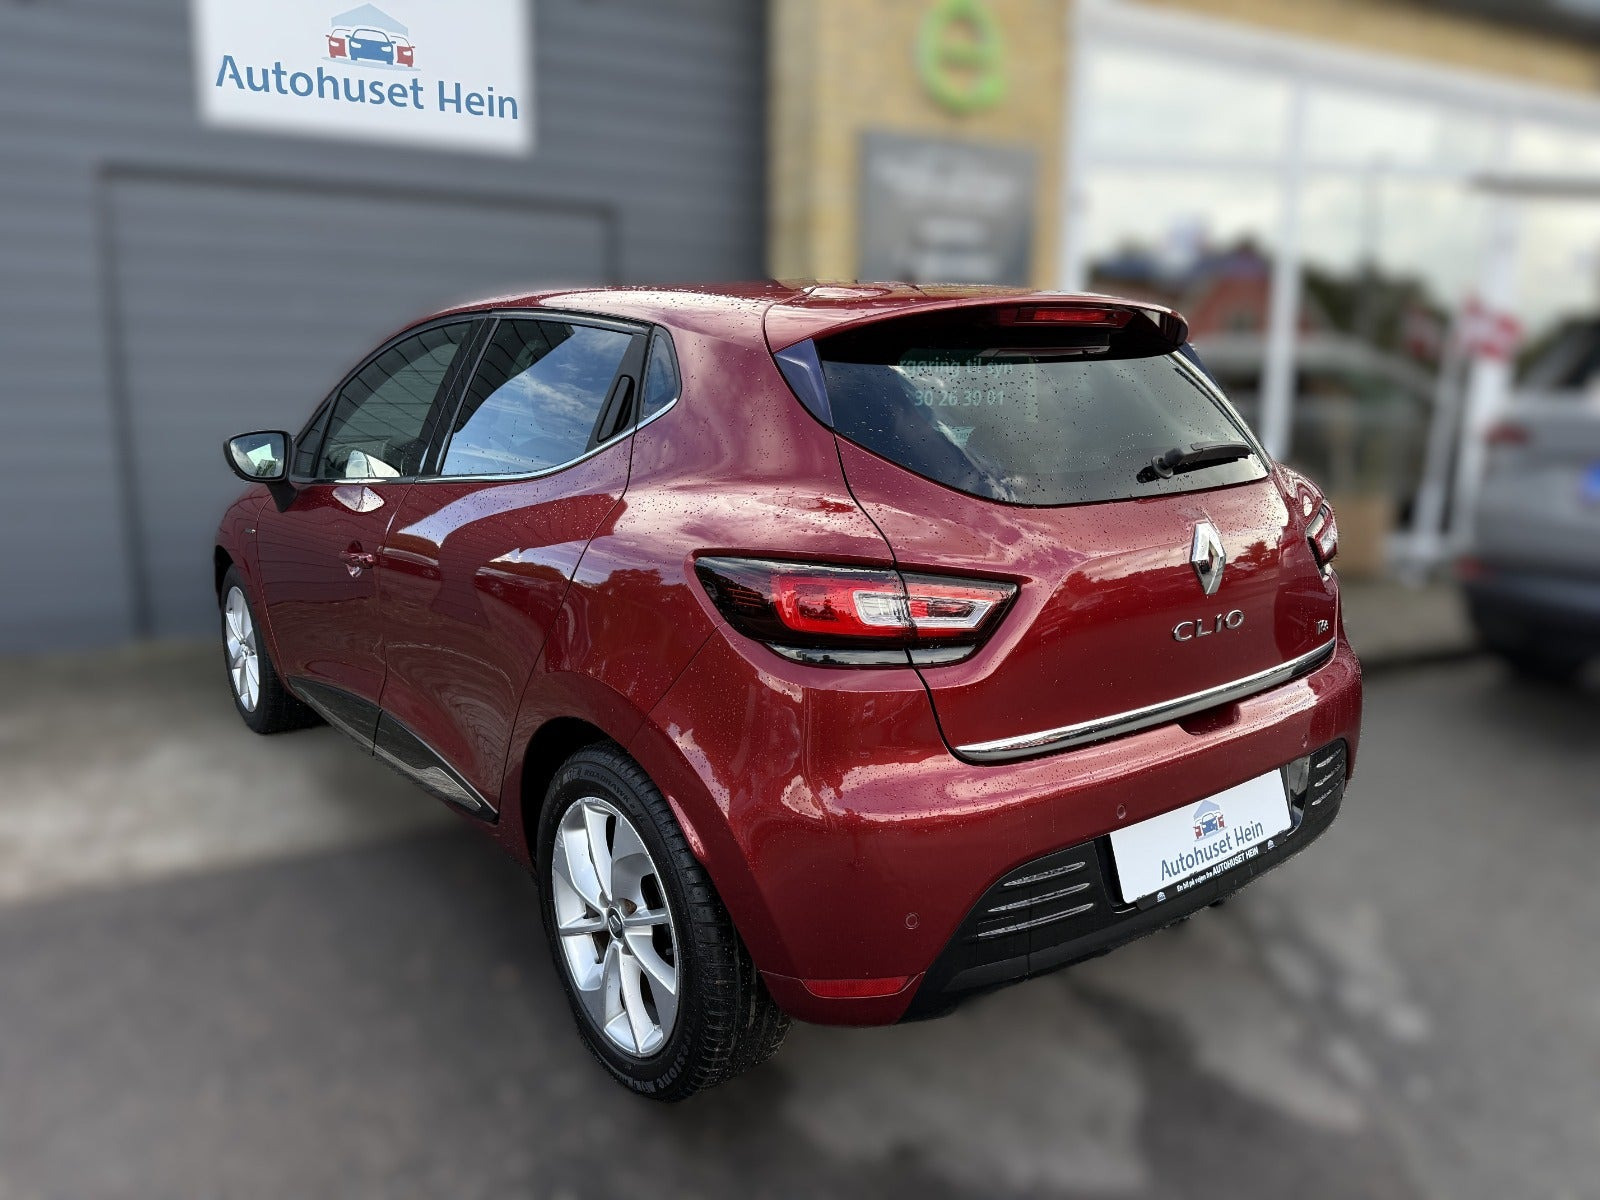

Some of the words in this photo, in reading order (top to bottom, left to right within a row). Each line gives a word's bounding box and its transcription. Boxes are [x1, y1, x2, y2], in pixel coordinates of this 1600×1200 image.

[216, 54, 425, 110] Autohuset
[438, 80, 519, 120] Hein
[914, 390, 935, 406] 30
[938, 390, 959, 407] 26
[1172, 609, 1245, 642] CLIO
[1161, 833, 1233, 881] Autohuset
[1234, 821, 1264, 847] Hein
[1212, 853, 1246, 876] AUTOHUSET
